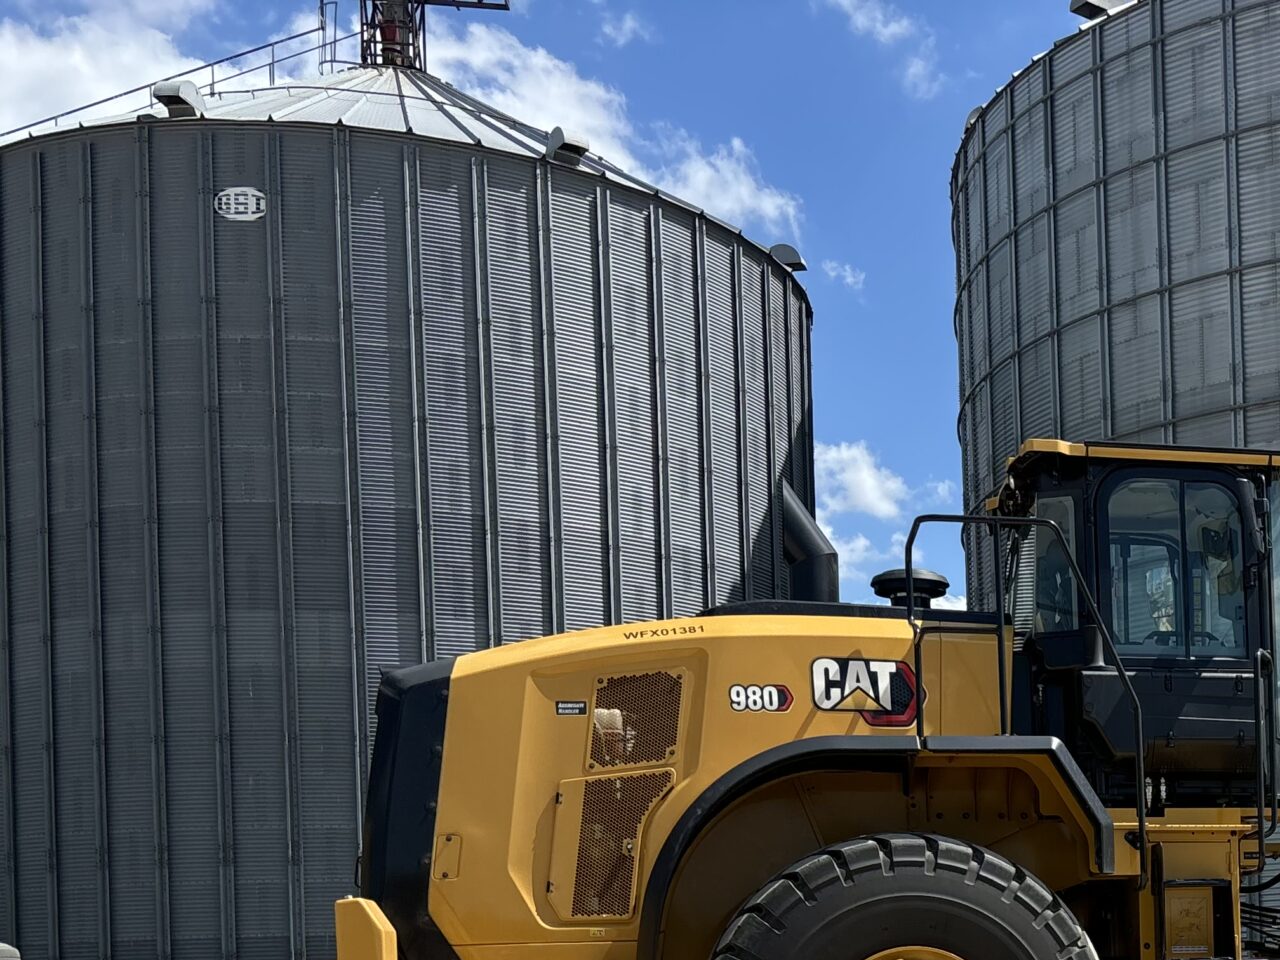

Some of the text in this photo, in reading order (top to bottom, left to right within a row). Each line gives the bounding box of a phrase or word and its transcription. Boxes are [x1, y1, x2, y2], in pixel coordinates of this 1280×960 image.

[217, 193, 266, 214] GSI
[623, 625, 705, 640] WFX01381
[812, 658, 897, 711] CAT
[730, 685, 779, 711] 980
